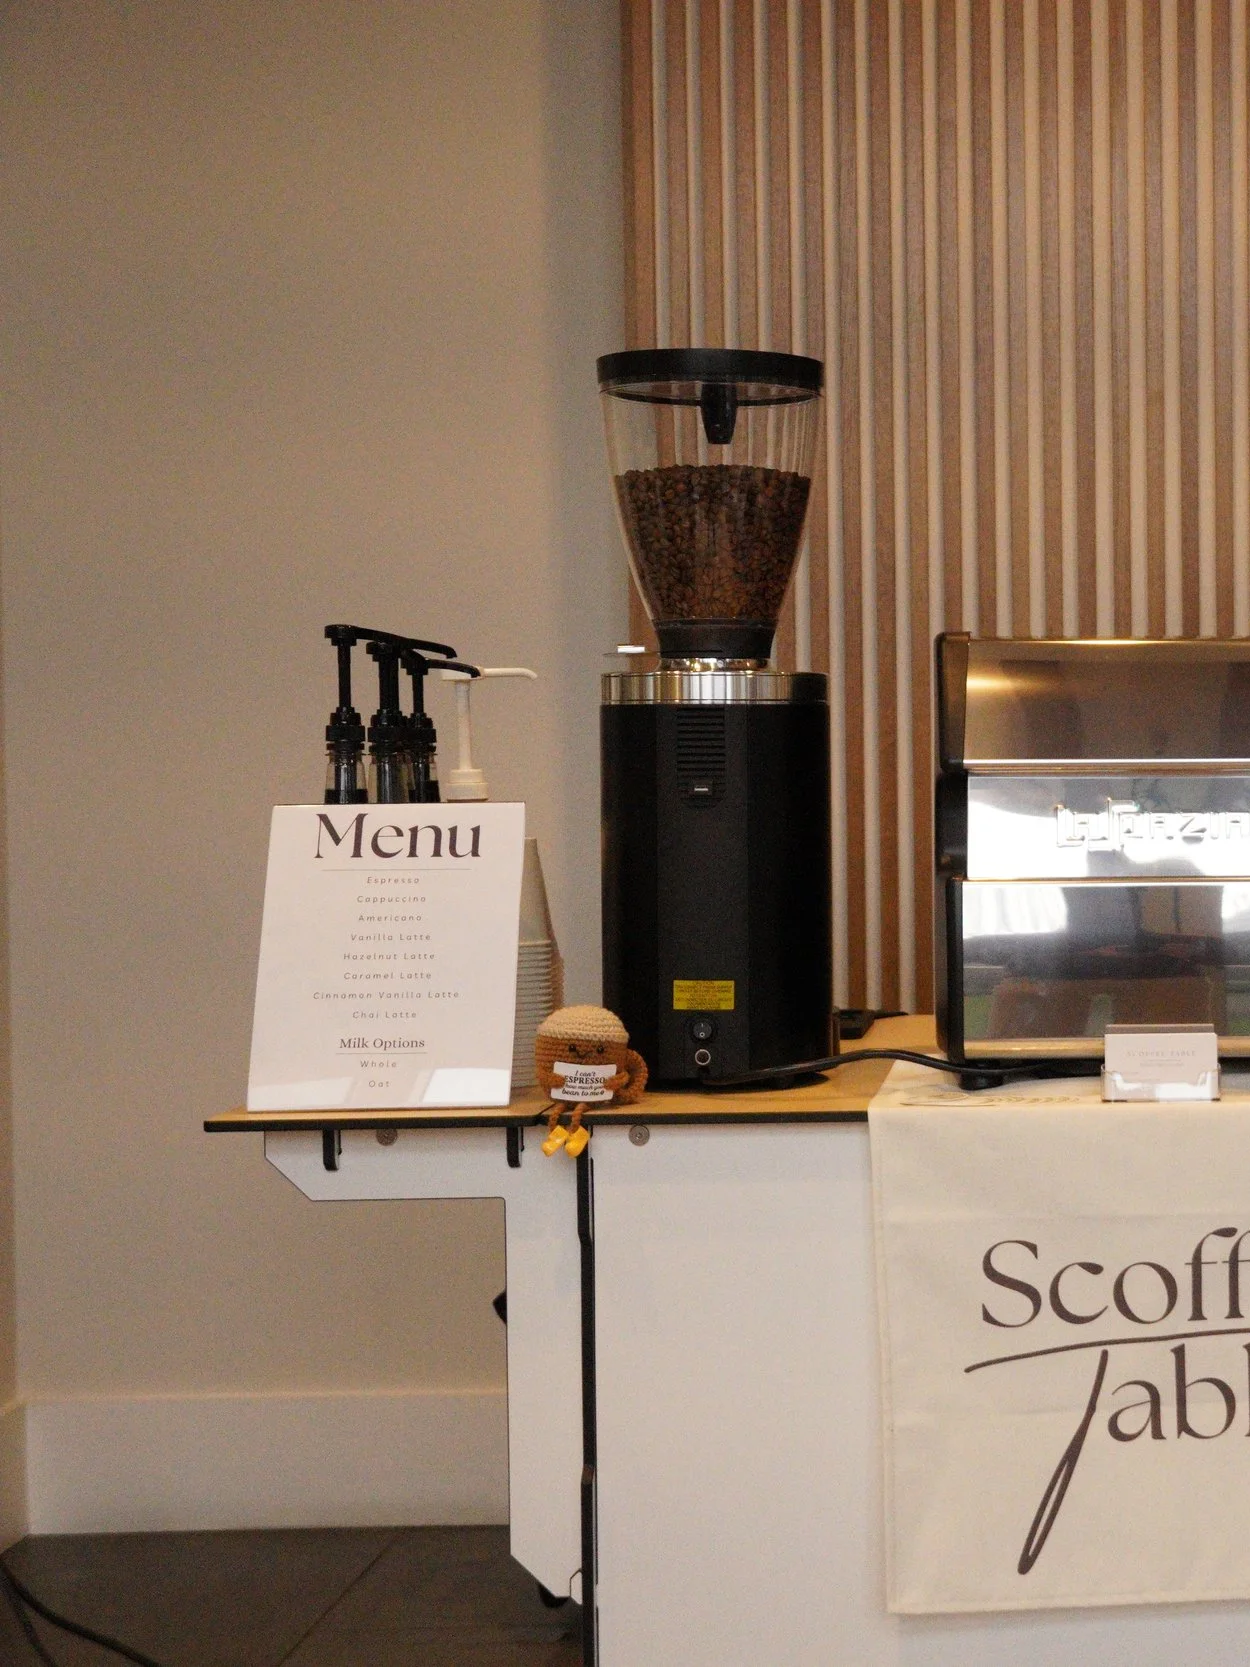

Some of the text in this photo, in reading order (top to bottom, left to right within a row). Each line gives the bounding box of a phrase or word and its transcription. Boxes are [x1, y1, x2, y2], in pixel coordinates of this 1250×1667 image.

[313, 813, 482, 859] Menu
[366, 876, 421, 885] Espresso
[356, 895, 427, 904] Cappuccino
[358, 914, 423, 922] Americano
[350, 933, 432, 942] Vanilla Latte
[343, 952, 435, 961] Hazelnut Latte
[343, 972, 432, 980] Caramel Latte
[312, 992, 373, 1000] Cinnamon
[378, 992, 423, 1000] Vanilla
[352, 1011, 418, 1019] Chai Latte
[339, 1036, 426, 1051] Milk Options
[360, 1060, 398, 1068] Whole
[367, 1080, 391, 1089] Oat
